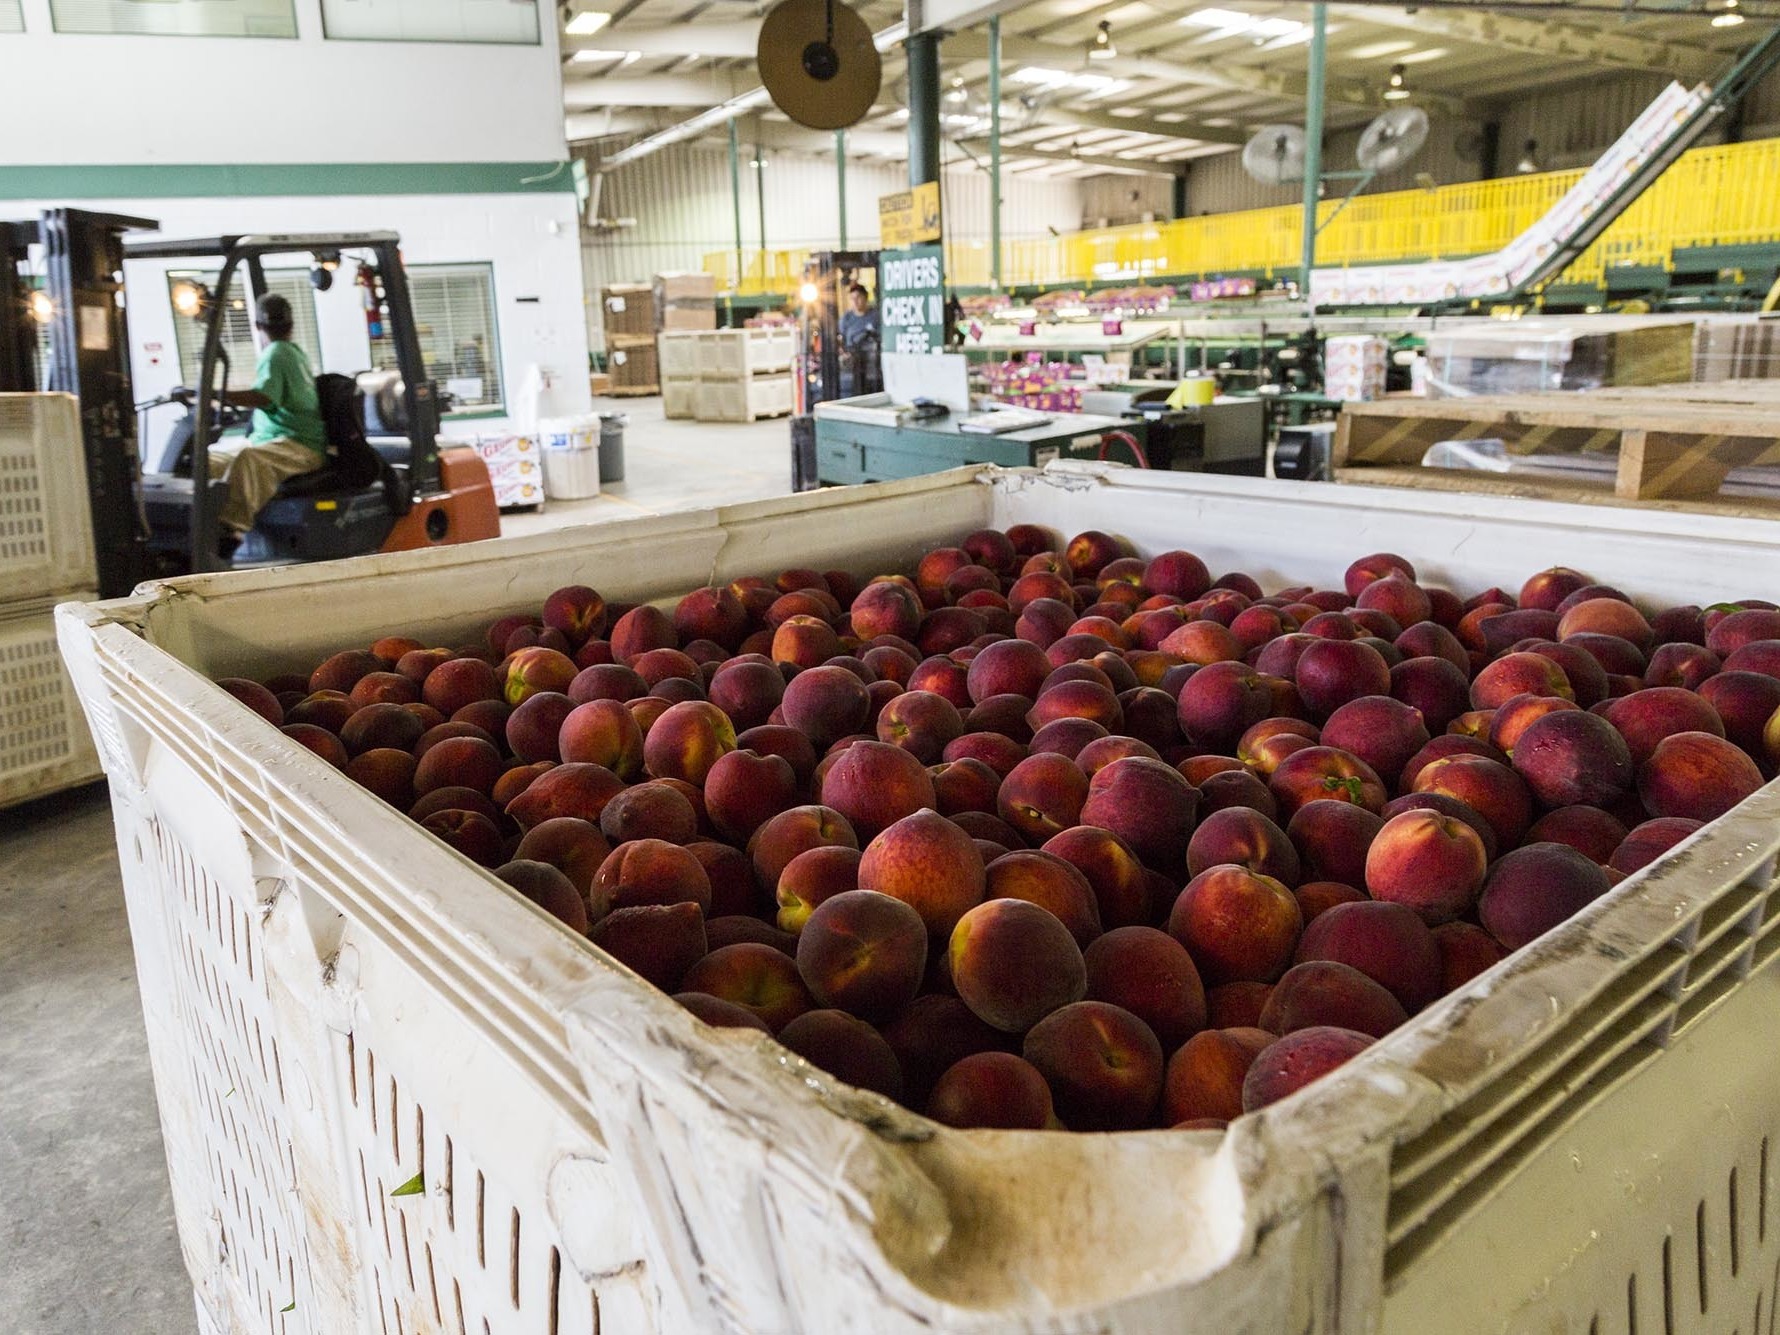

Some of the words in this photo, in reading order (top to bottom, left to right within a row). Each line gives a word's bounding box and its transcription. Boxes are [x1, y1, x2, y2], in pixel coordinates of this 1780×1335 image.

[884, 257, 939, 290] DRIVERS
[882, 295, 925, 327] CHECK
[928, 294, 943, 325] IN
[895, 332, 930, 353] HERE
